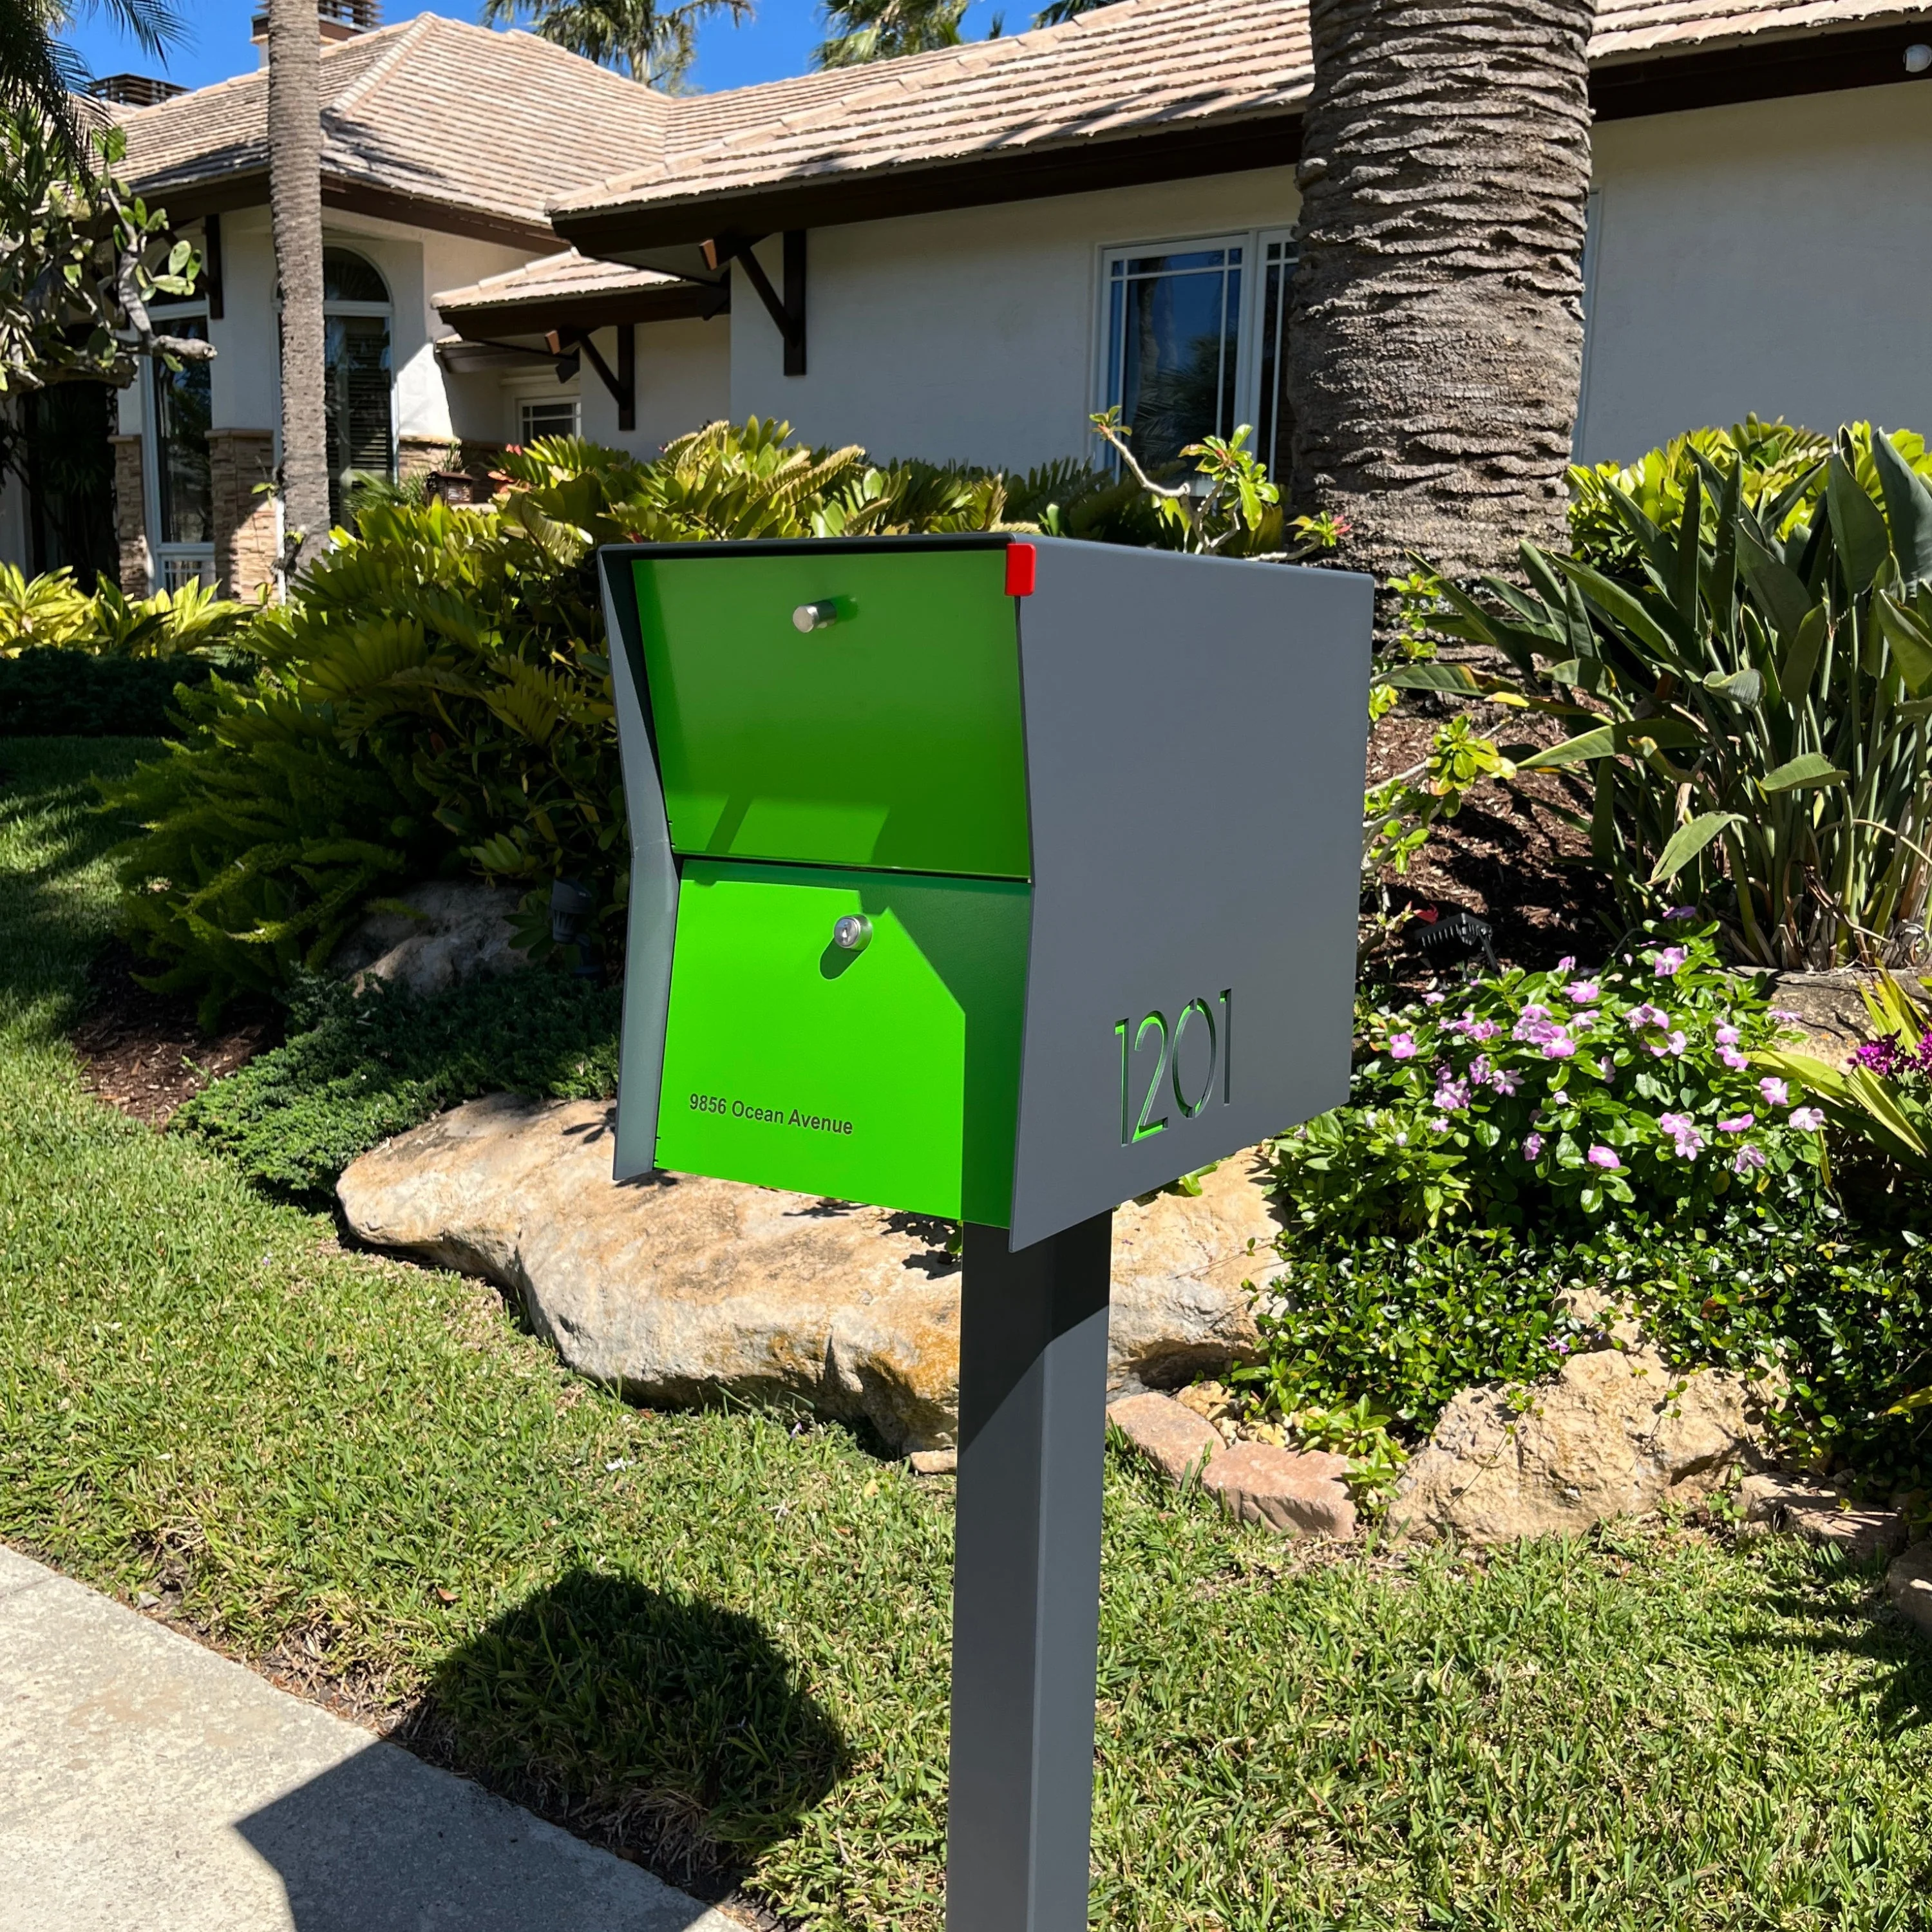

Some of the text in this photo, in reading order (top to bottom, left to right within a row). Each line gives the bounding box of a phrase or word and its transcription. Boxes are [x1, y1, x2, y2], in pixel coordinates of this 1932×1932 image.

[689, 1093, 853, 1135] 9856 Ocean Avenue
[1115, 988, 1232, 1147] 1201
